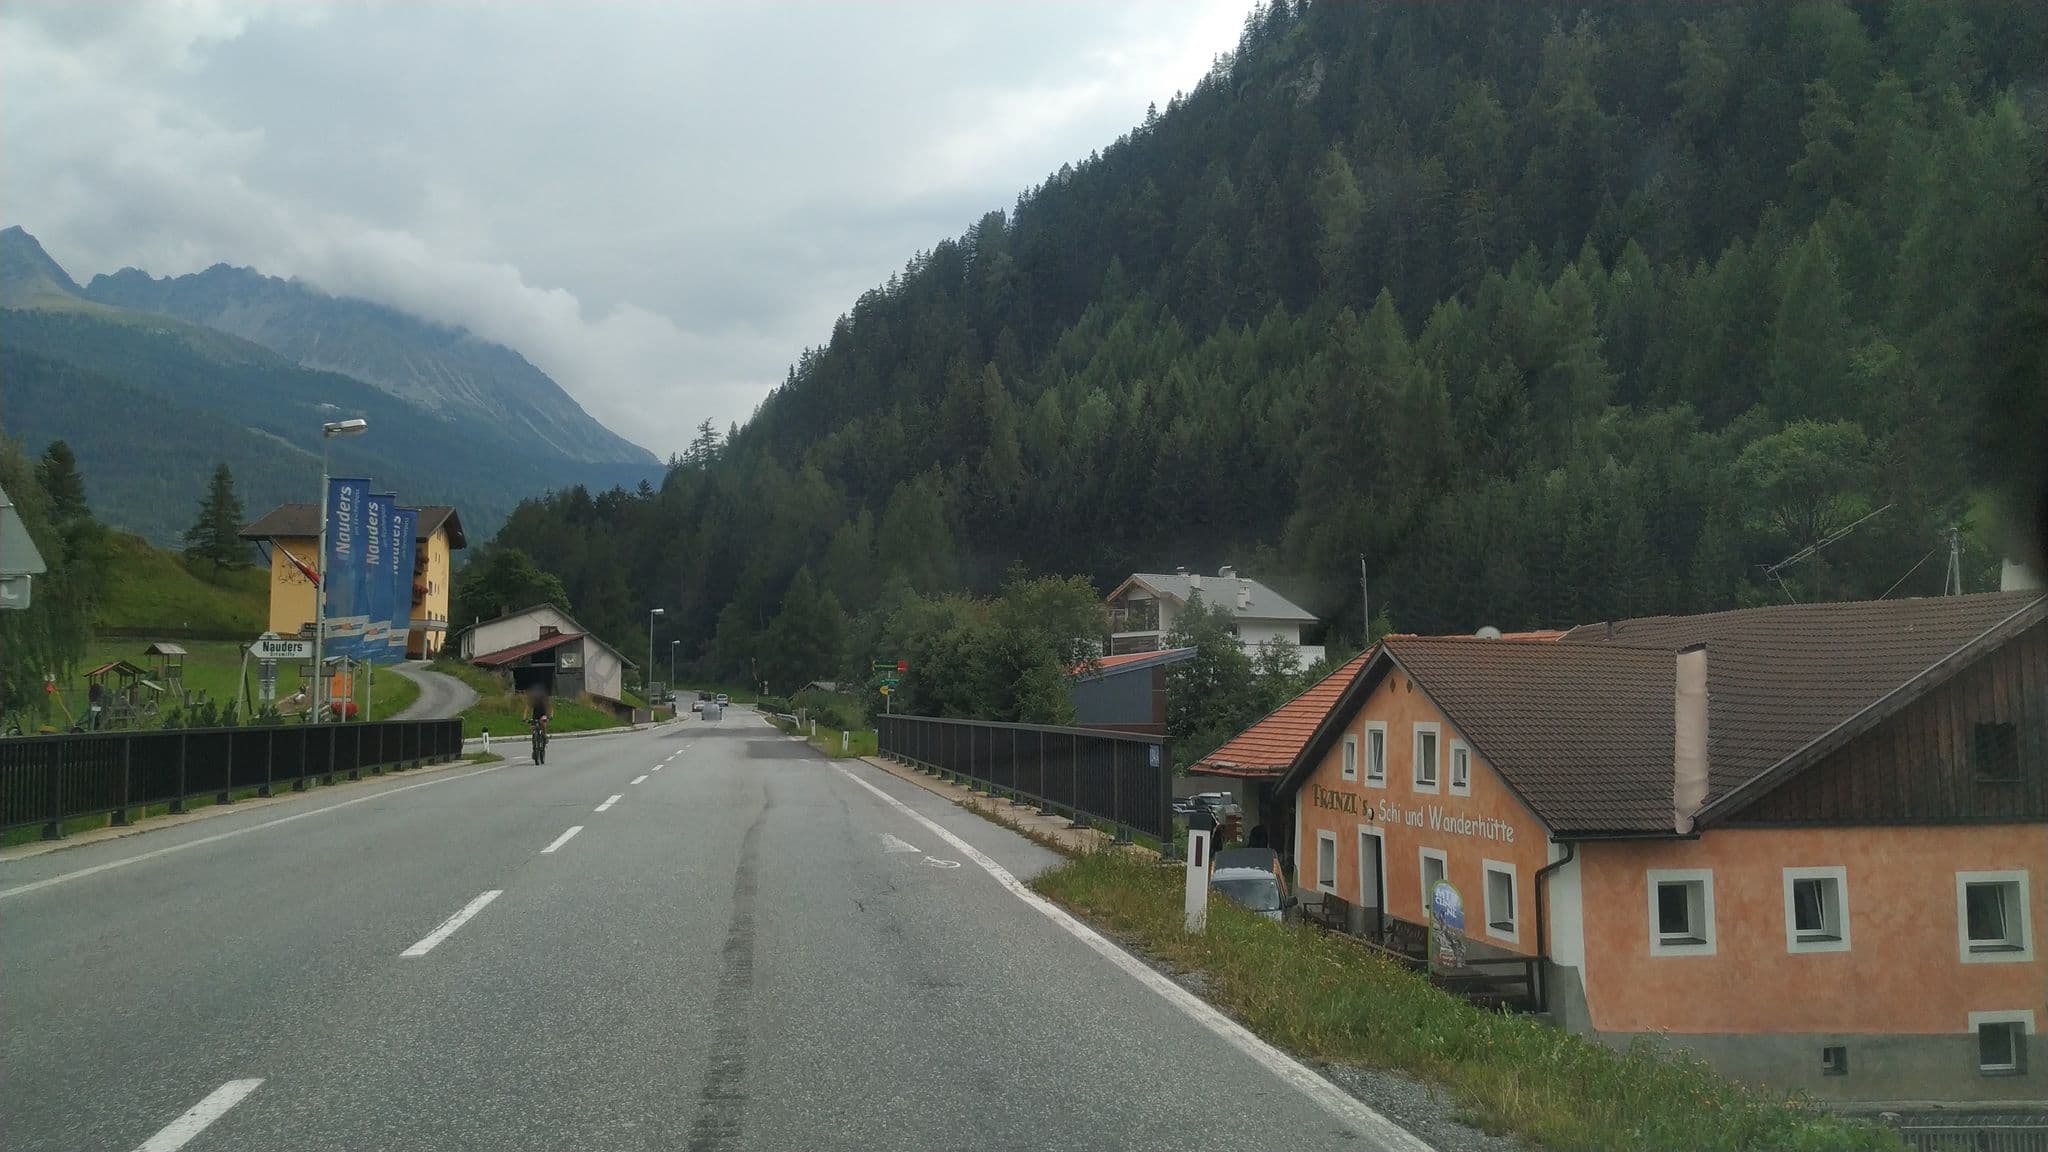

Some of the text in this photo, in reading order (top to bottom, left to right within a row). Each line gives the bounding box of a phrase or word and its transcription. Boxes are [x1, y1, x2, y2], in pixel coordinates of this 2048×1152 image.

[336, 486, 352, 554] Nauders
[366, 502, 380, 565] Nauders
[262, 641, 303, 652] Nauders
[1378, 799, 1401, 824] Schi
[1405, 806, 1424, 828] und
[1428, 804, 1514, 842] Wanderhütte
